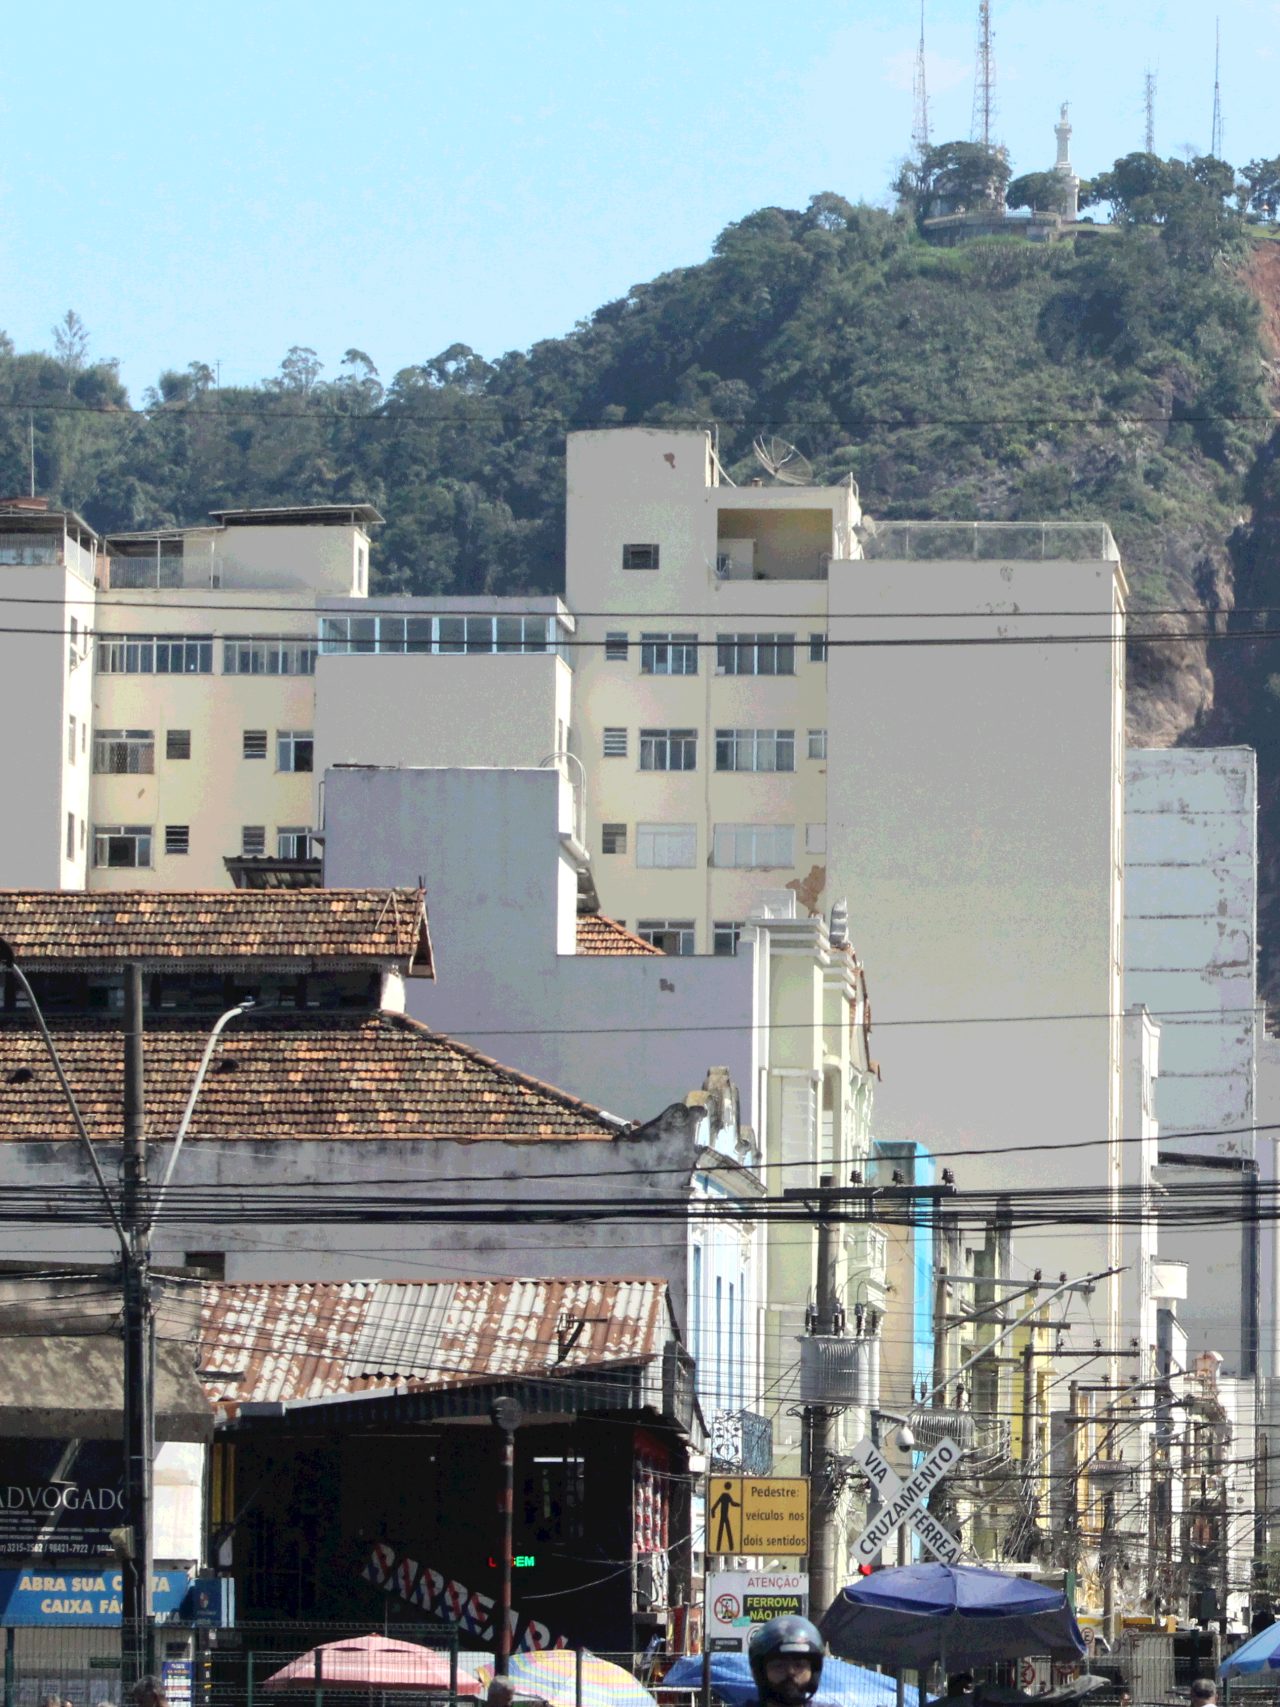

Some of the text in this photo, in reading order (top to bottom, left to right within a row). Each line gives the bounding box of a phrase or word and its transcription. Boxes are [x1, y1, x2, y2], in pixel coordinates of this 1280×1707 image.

[864, 1450, 888, 1483] VIA
[751, 1486, 800, 1498] Pedestre:
[859, 1447, 953, 1555] CRUZAMENTO
[788, 1510, 805, 1521] nos
[743, 1534, 807, 1546] dois sentidos
[19, 1576, 170, 1592] ABRA SUA CTA
[748, 1575, 799, 1590] ATENÇÃO
[41, 1599, 93, 1613] CAIXA
[747, 1597, 799, 1607] FERROVIA
[750, 1608, 772, 1621] NÃO
